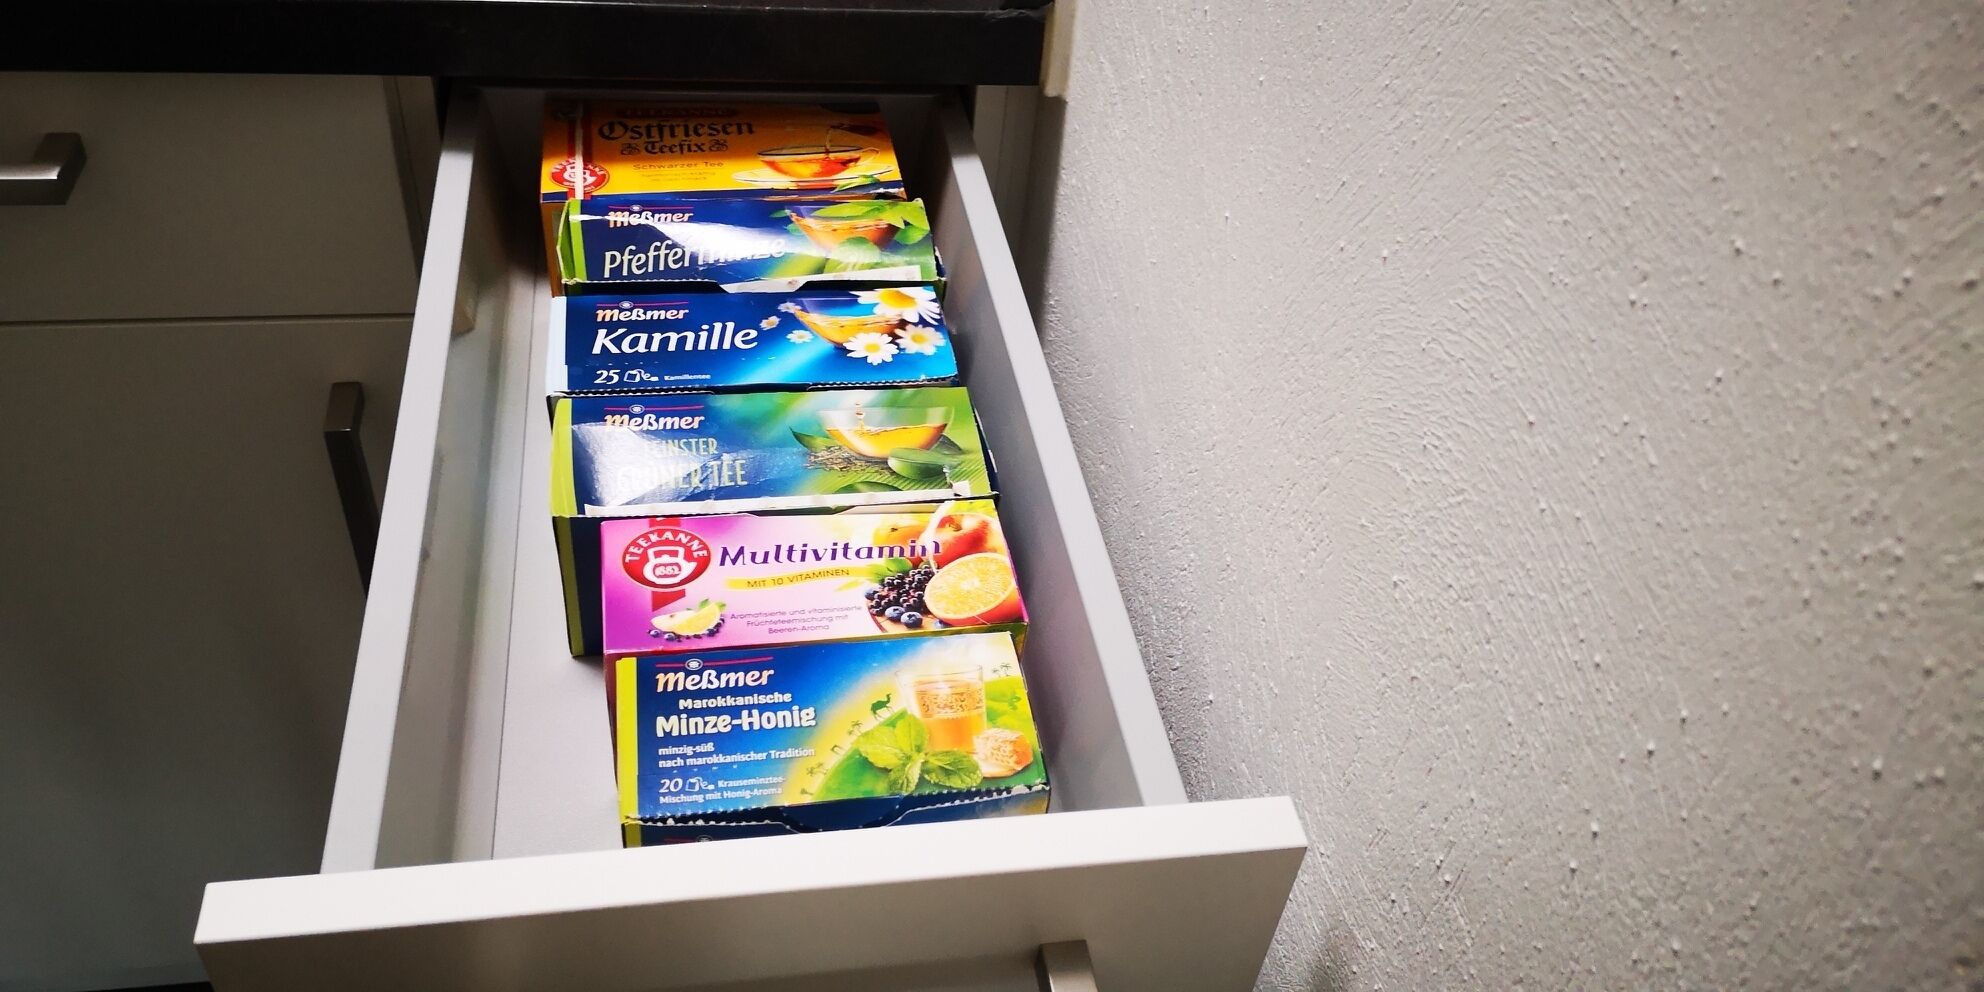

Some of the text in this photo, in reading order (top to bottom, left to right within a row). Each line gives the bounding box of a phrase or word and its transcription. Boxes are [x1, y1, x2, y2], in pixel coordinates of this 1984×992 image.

[598, 120, 755, 141] Ostfriesen
[644, 139, 706, 155] Teefix
[633, 161, 698, 170] Schwarzer
[608, 210, 694, 228] Meßmer
[604, 239, 786, 278] Pfeffermze
[596, 308, 689, 322] Meßmer
[592, 322, 758, 354] Kamille
[594, 369, 621, 385] 25
[605, 413, 705, 431] Meßmer
[645, 437, 719, 457] EINSTER
[709, 459, 748, 487] TEE
[625, 531, 709, 563] TEEKANNE
[719, 540, 941, 567] Multivitamin
[747, 568, 850, 589] MIT 10 VITAMINEN
[730, 604, 862, 620] Aromatisierte und vitaminisierte
[835, 613, 849, 622] mit
[768, 624, 830, 635] Beeren-Aroma
[656, 669, 774, 692] Meßmer
[679, 692, 792, 710] Marokkanische
[656, 706, 816, 737] Minze-Honig
[658, 742, 715, 756] minzig-süß
[658, 748, 814, 768] nach marokkanischer Tradition
[659, 778, 683, 793] 20
[659, 788, 782, 804] Mischung mit Honig-Aroma
